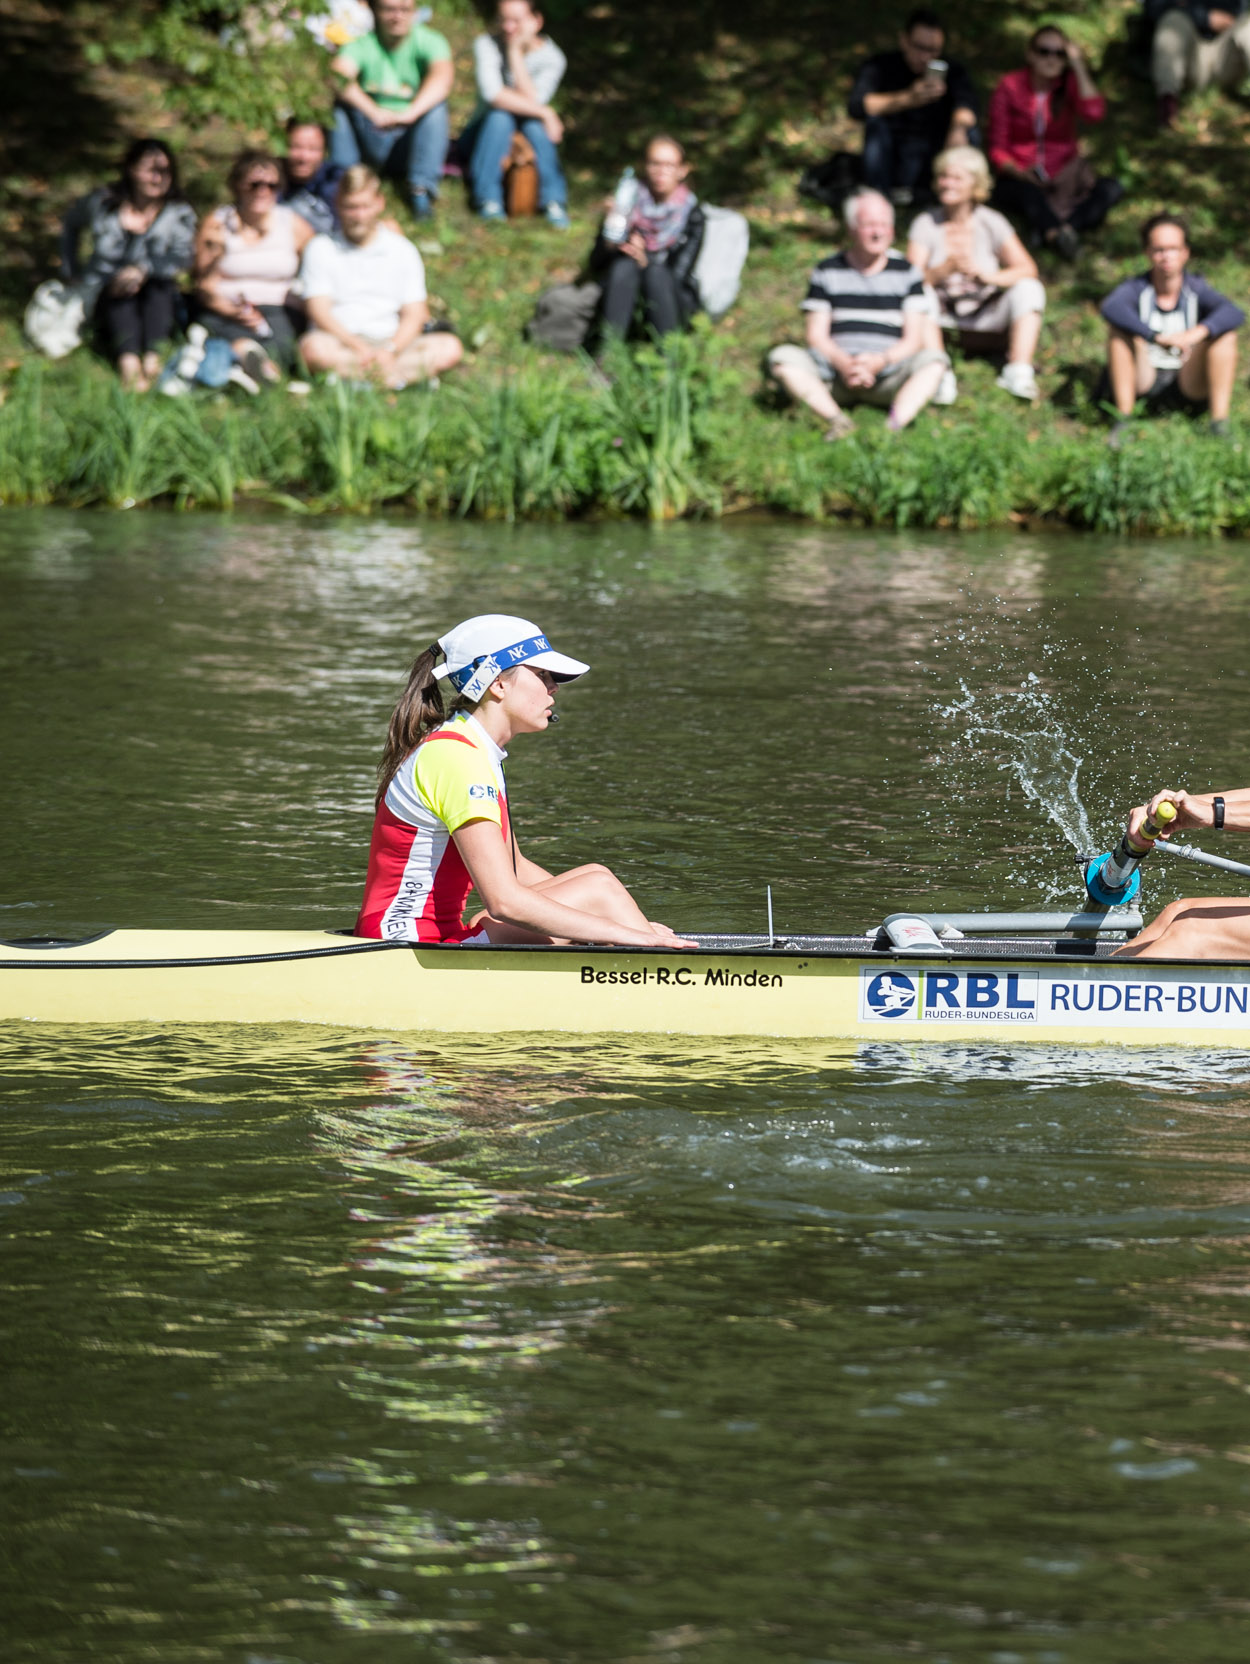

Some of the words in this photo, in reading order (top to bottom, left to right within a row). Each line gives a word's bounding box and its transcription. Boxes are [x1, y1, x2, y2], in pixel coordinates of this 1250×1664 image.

[507, 644, 528, 662] NK
[581, 966, 697, 986] Bessel-R.C.
[704, 968, 783, 988] Minden
[926, 972, 1035, 1008] RBL
[925, 1010, 1035, 1020] RUDER-BUNDESLIGA
